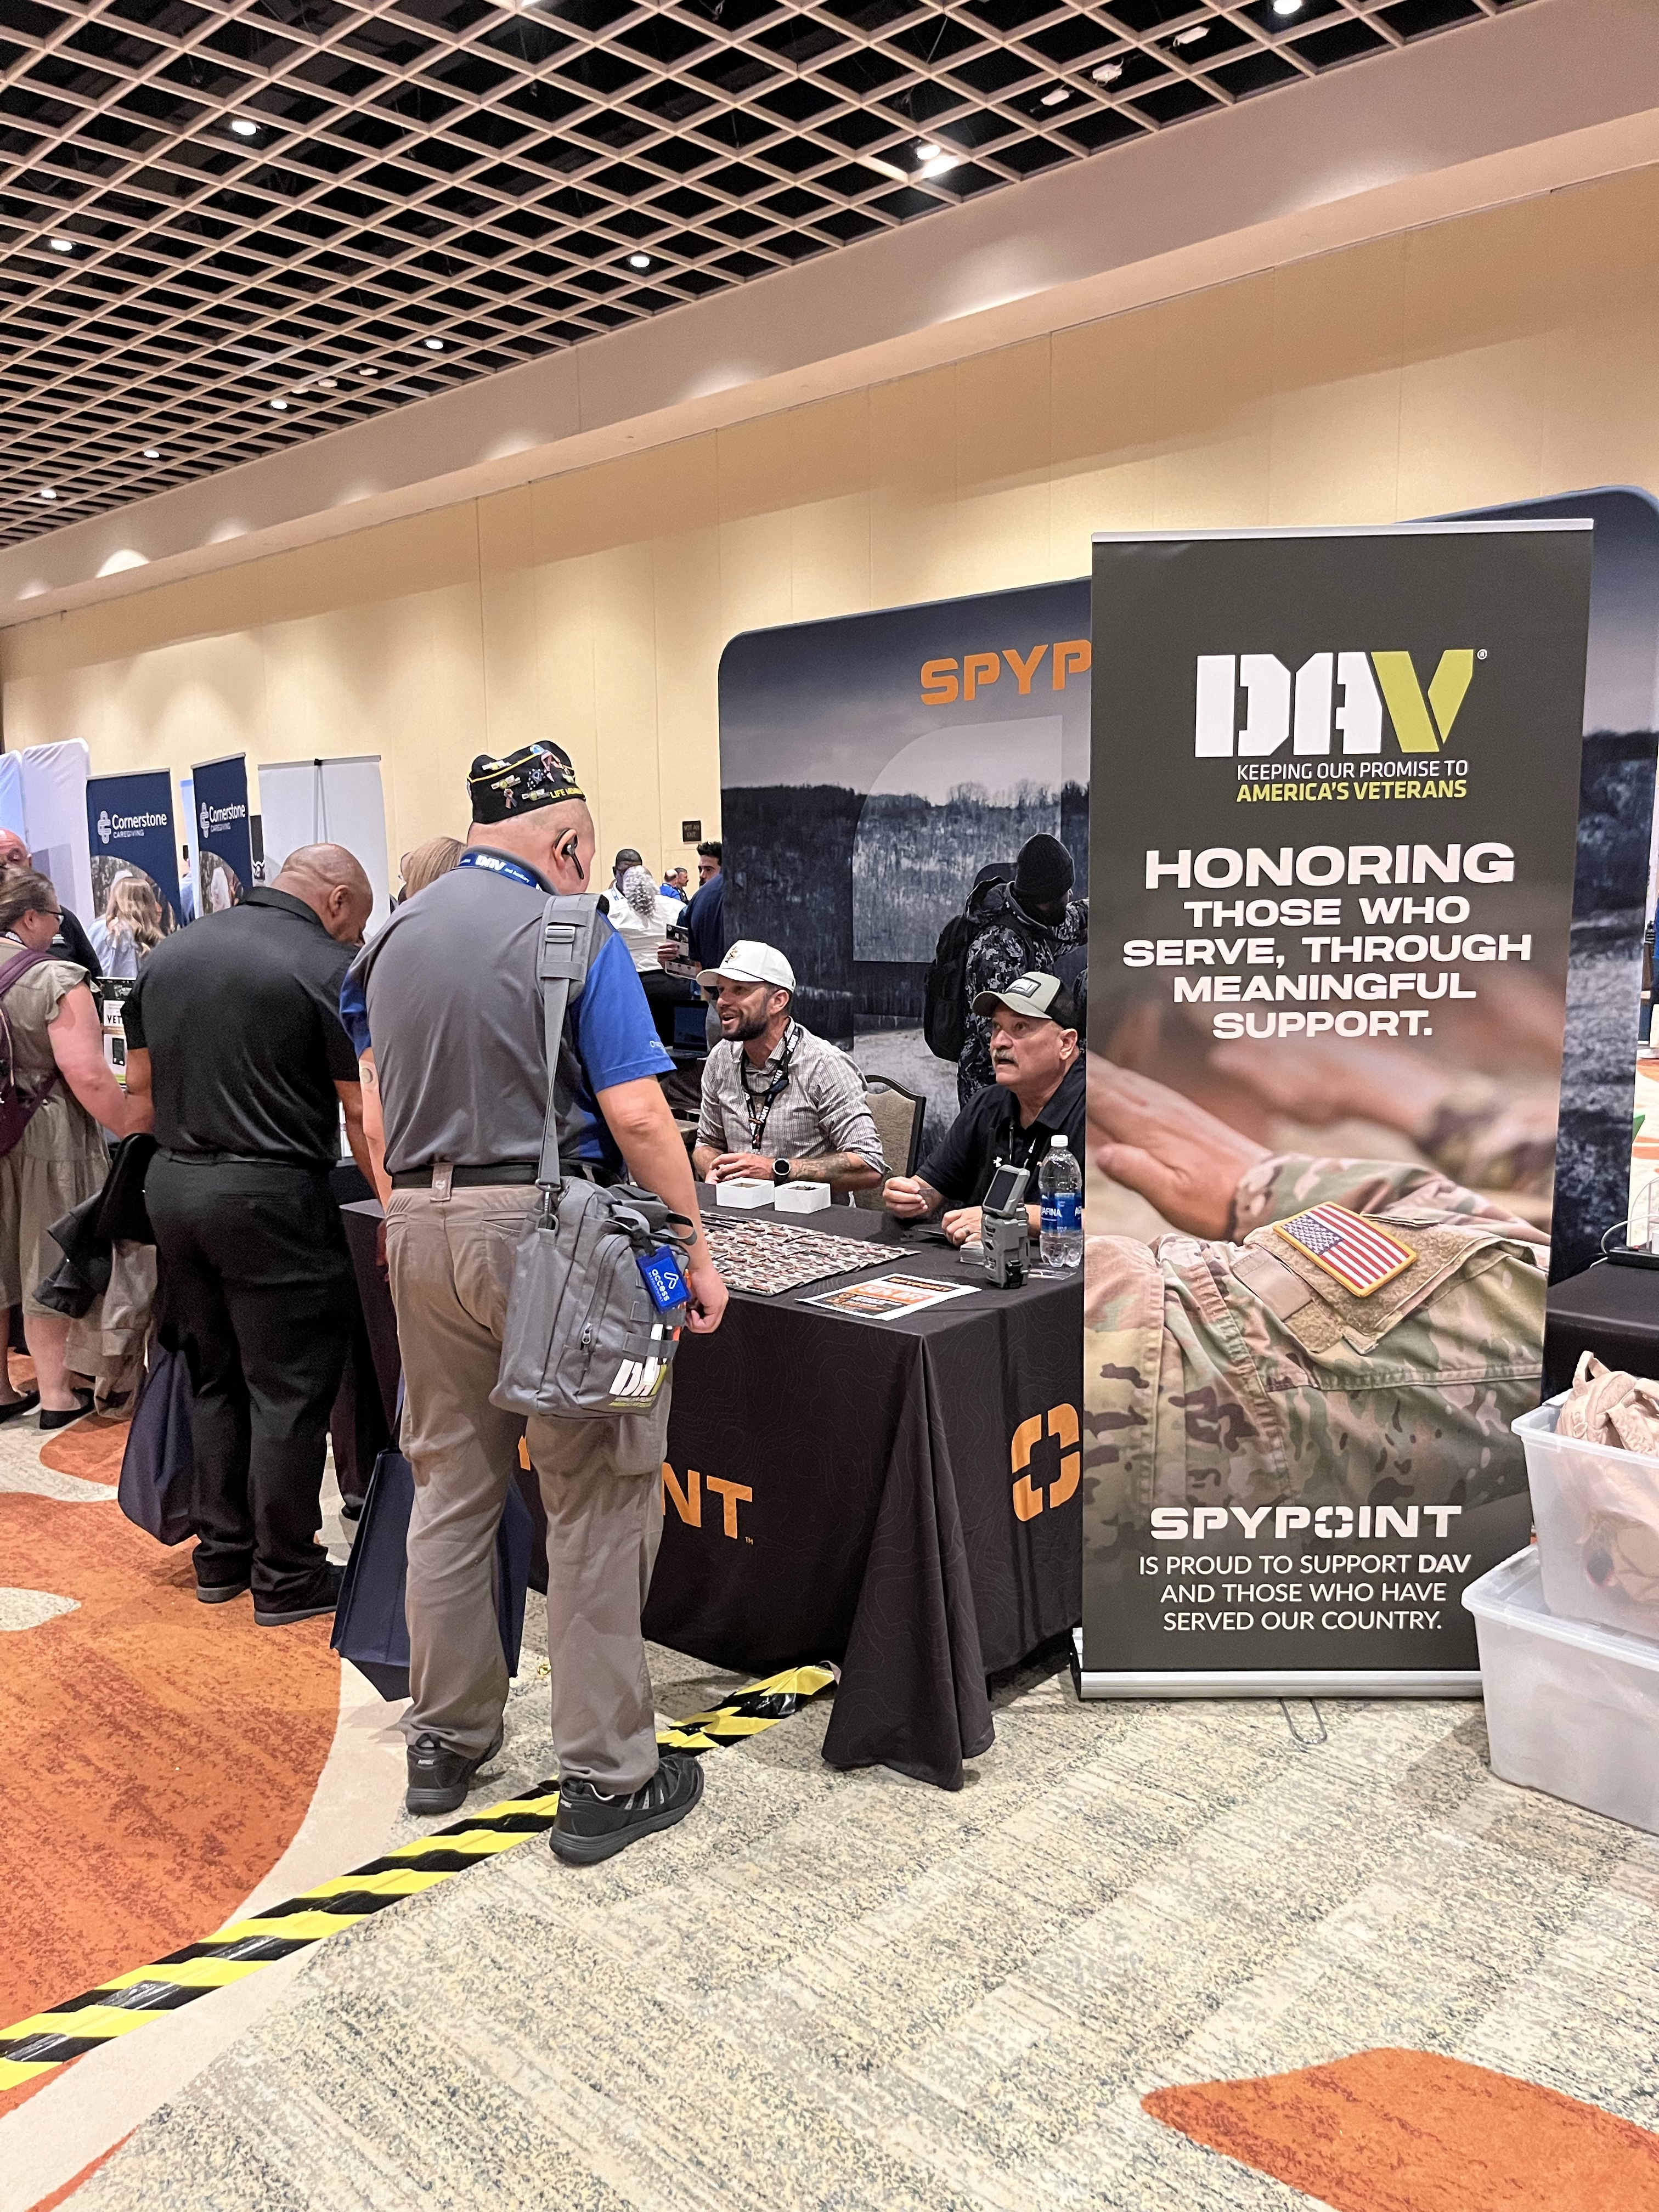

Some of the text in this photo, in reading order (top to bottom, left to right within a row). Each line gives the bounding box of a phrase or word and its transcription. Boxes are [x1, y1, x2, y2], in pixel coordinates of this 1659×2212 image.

[1195, 649, 1474, 758] DAV
[1237, 760, 1468, 781] KEEPING OUR PROMISE TO
[550, 788, 566, 799] LIFE
[1237, 780, 1467, 802] AMERICA'S VETERANS
[112, 812, 167, 830] Cornerstone
[209, 803, 246, 823] Cornerstone
[113, 829, 144, 839] CAREGIVING
[475, 855, 507, 871] DAV
[1146, 842, 1515, 889] HONORING
[1184, 895, 1470, 928] THOSE WHO
[1122, 934, 1532, 969] SERVE, THROUGH
[1174, 972, 1476, 1003] MEANINGFUL
[1212, 1009, 1432, 1039] SUPPORT.
[652, 1269, 670, 1301] access
[1150, 1505, 1462, 1539] SPYPOINT
[1139, 1554, 1471, 1575] IS PROUD TO SUPPORT DAV
[1160, 1583, 1447, 1602] AND THOSE WHO HAVE
[1164, 1611, 1442, 1630] SERVED OUR COUNTRY.
